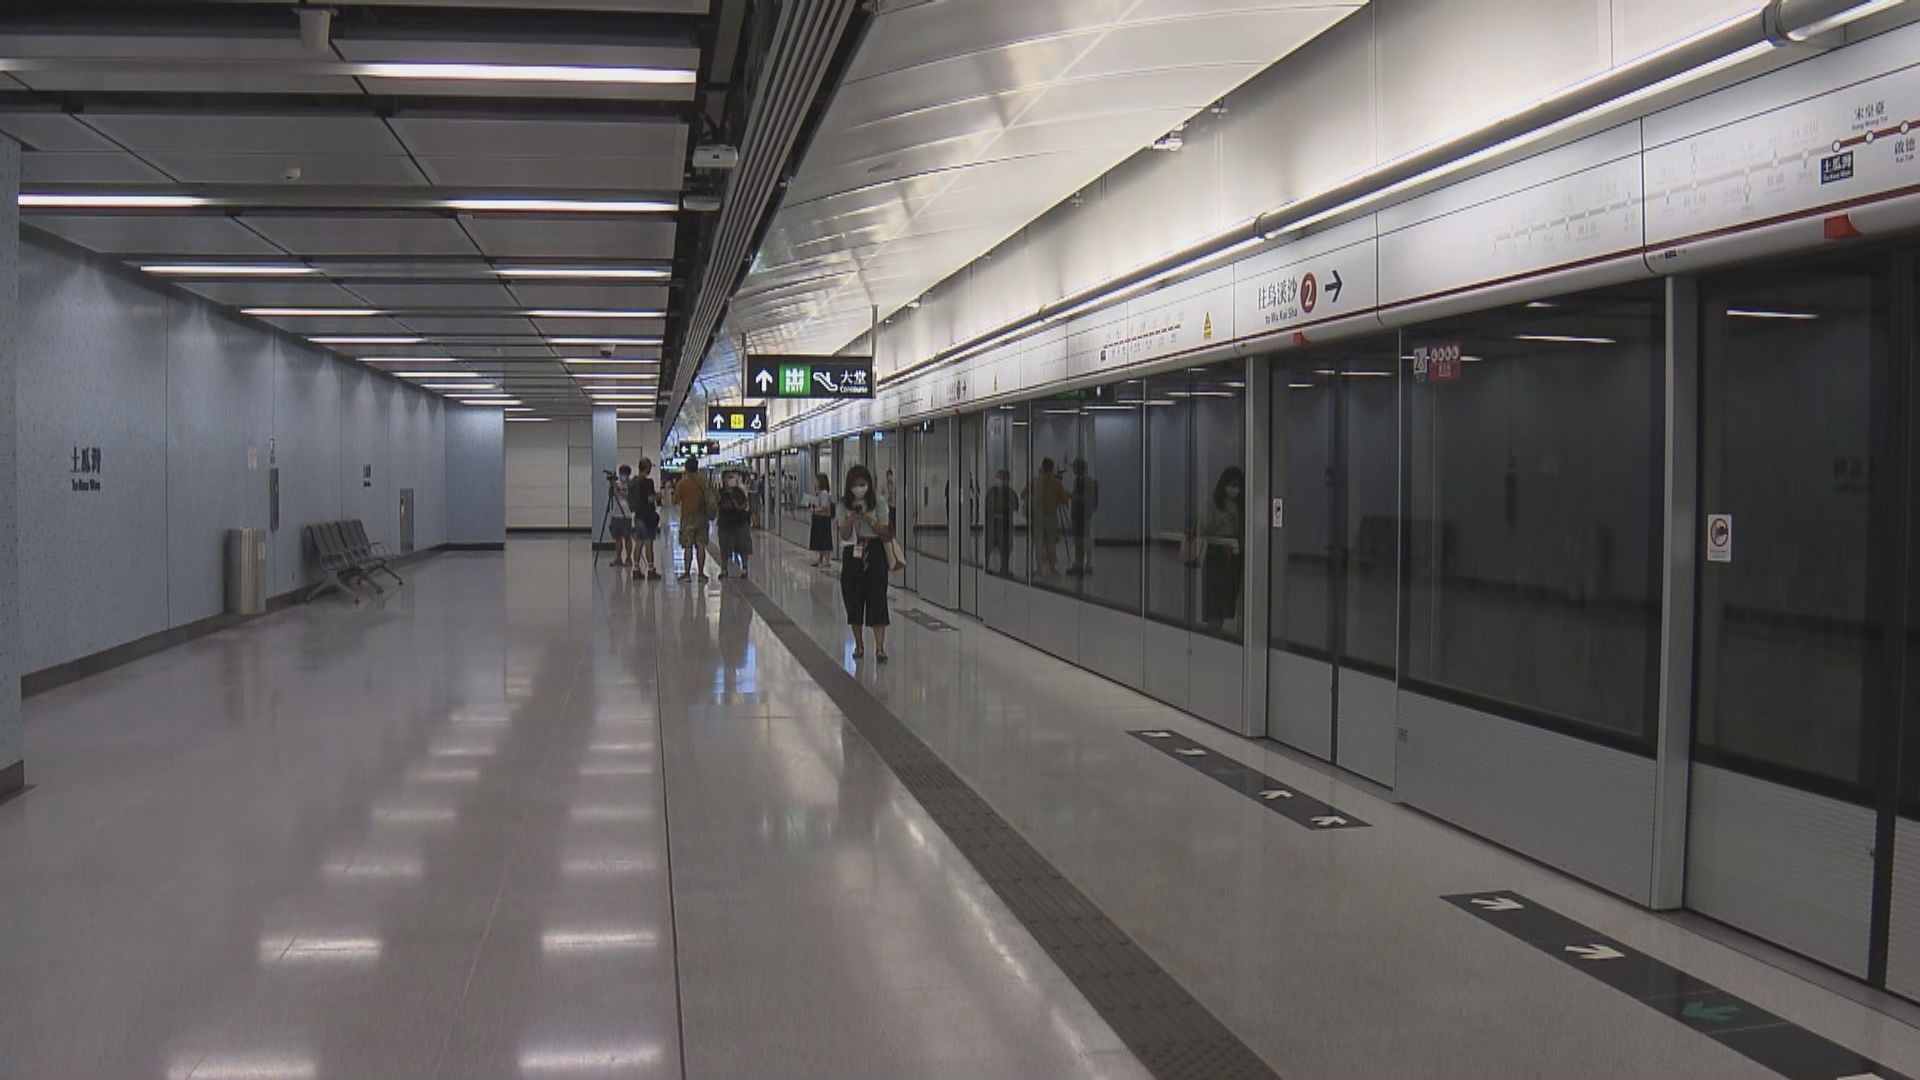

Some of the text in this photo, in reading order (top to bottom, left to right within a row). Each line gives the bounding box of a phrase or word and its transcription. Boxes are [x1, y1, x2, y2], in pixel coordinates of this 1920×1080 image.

[1258, 277, 1298, 310] 往烏溪沙
[840, 369, 867, 385] 大堂
[785, 384, 804, 393] EXIT
